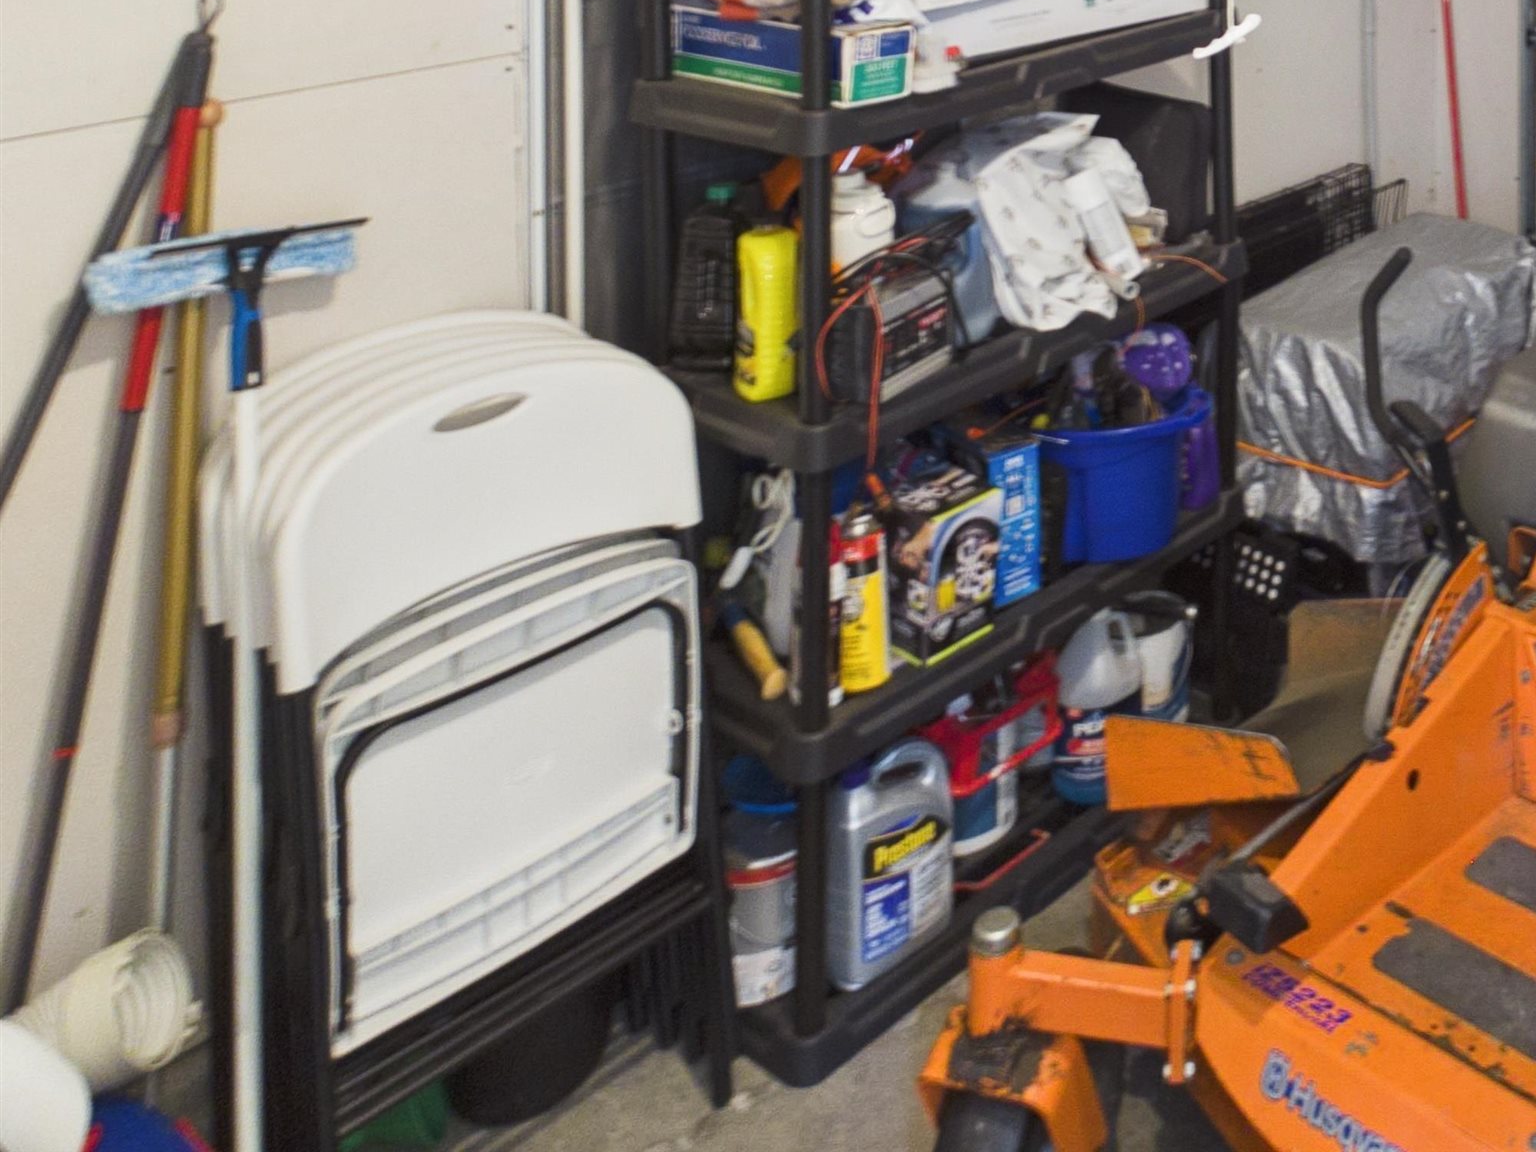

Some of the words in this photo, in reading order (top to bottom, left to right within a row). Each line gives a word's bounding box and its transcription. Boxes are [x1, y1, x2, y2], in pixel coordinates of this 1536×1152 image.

[1072, 719, 1105, 738] PEA
[873, 819, 938, 873] Prestone
[1286, 1071, 1408, 1152] Husqva
